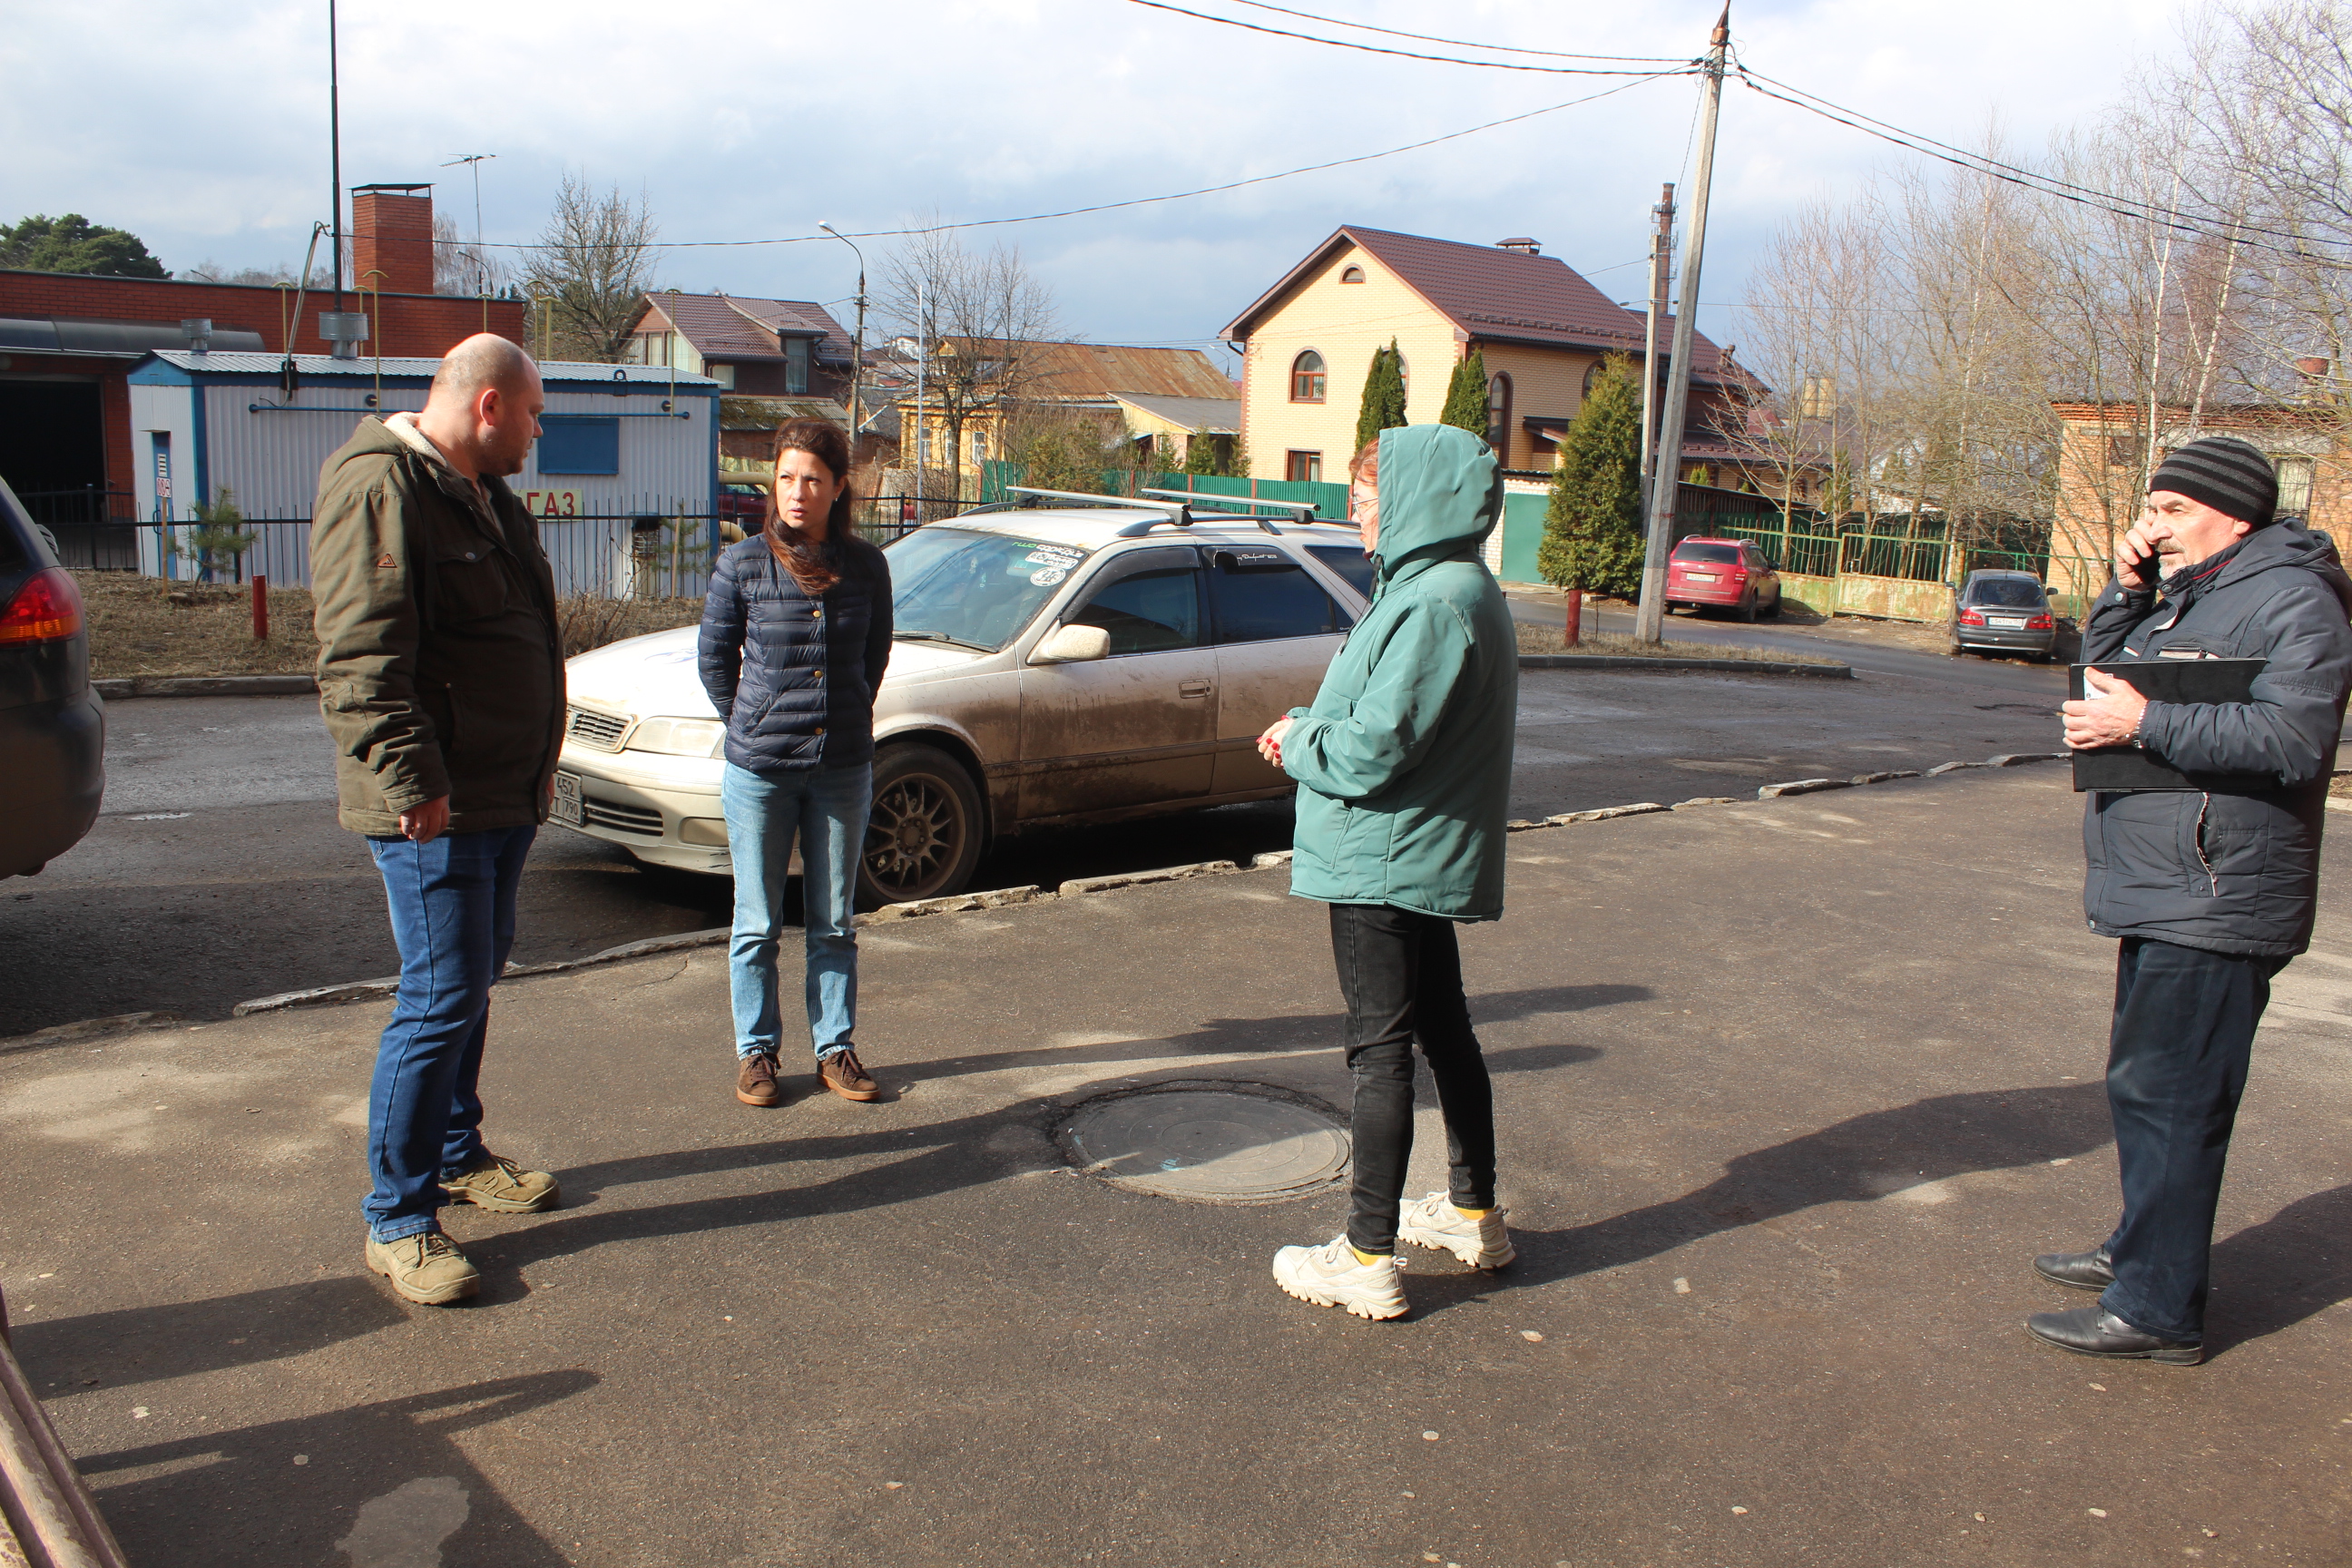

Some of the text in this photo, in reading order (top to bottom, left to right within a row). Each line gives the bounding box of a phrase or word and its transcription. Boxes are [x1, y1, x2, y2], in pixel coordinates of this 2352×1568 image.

[526, 492, 575, 516] ГАЗ
[556, 777, 574, 797] 452
[564, 799, 578, 816] 790
